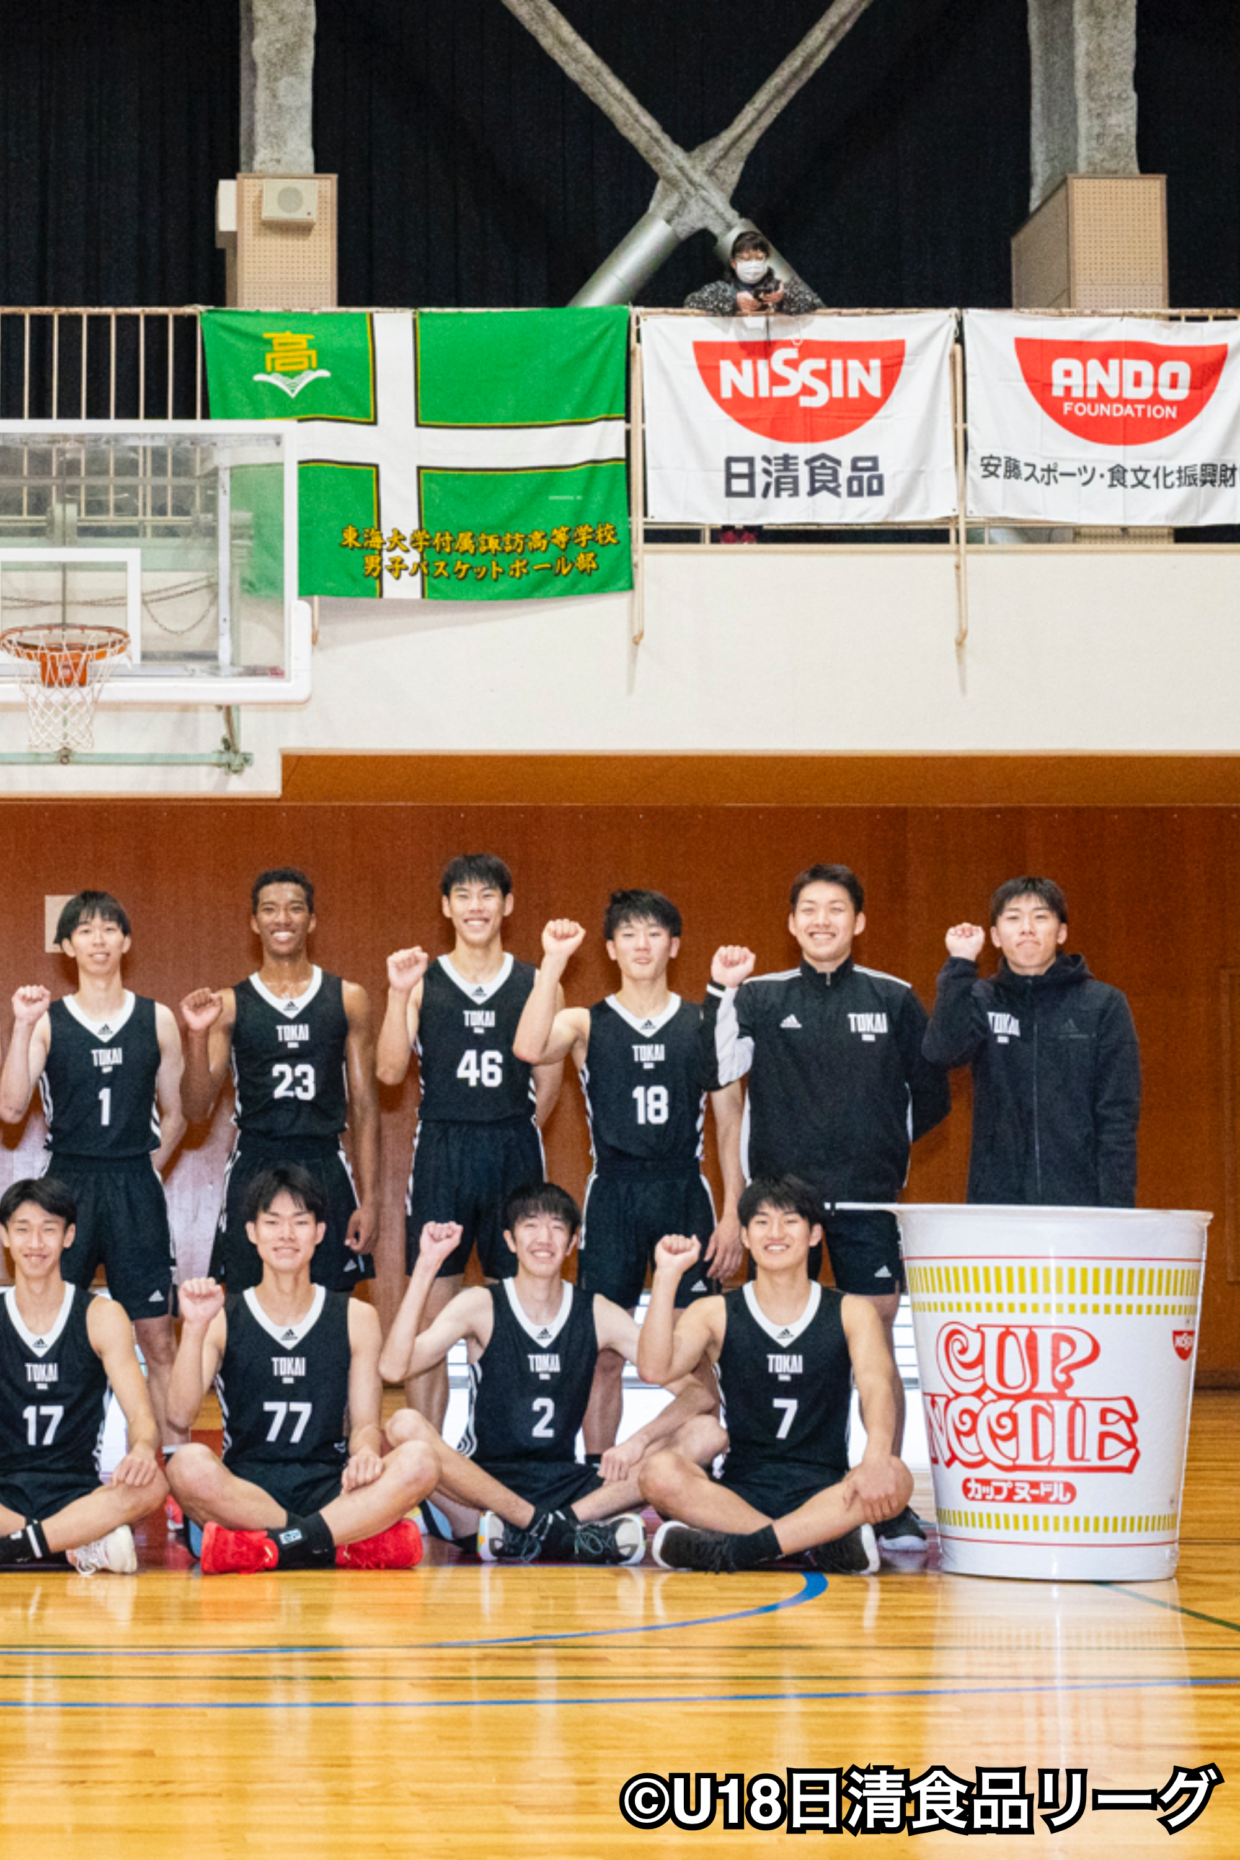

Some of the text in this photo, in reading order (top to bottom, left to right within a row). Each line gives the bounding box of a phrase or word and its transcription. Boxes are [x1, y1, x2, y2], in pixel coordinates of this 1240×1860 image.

[720, 347, 882, 408] NISSIN
[1051, 357, 1191, 400] ANDO
[1063, 401, 1178, 419] FOUNDATION
[724, 452, 885, 499] 日清食品
[340, 522, 619, 554] 東海大学付属諏訪高等学校
[363, 551, 598, 580] 男子バスケットボール部
[276, 1024, 310, 1042] TOKAI
[463, 1010, 496, 1027] TOKAI
[847, 1013, 888, 1033] TOKAI
[987, 1011, 1021, 1037] TOKAI
[91, 1047, 123, 1066] TOKAI
[632, 1044, 666, 1062] TOKAI
[272, 1064, 316, 1100] 23
[456, 1050, 503, 1088] 46
[98, 1088, 111, 1126] 1
[632, 1086, 669, 1125] 18
[25, 1363, 58, 1383] TOKAI
[271, 1357, 306, 1376] TOKAI
[527, 1354, 560, 1373] TOKAI
[766, 1355, 803, 1374] TOKAI
[936, 1321, 1101, 1396] CUP
[23, 1405, 64, 1446] 17
[263, 1402, 313, 1443] 77
[531, 1398, 555, 1438] 2
[773, 1399, 798, 1439] 7
[966, 1478, 1072, 1502] カップヌードル
